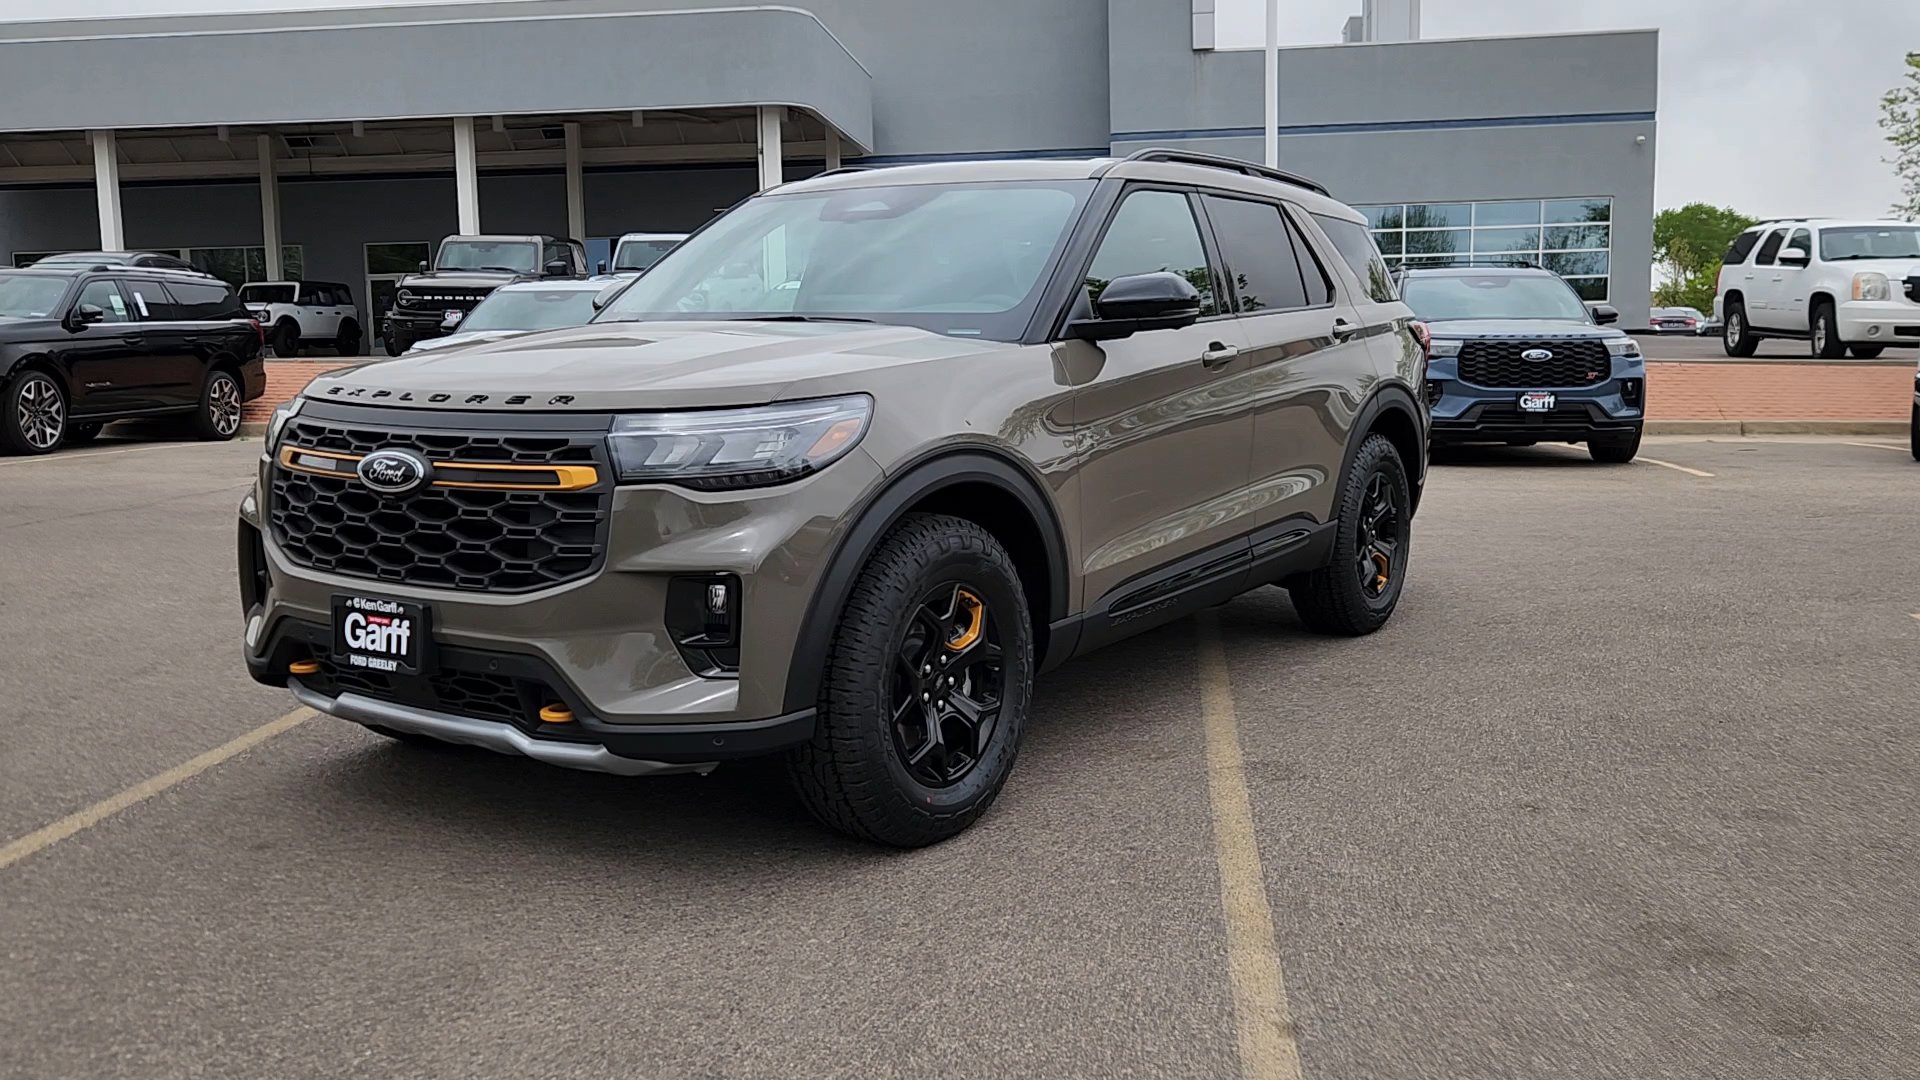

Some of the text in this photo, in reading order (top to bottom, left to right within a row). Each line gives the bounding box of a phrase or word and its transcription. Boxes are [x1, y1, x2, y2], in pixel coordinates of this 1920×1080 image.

[327, 386, 576, 405] EXPLORER
[1520, 395, 1555, 409] Garff
[368, 458, 406, 483] Ford
[344, 611, 411, 656] Garff
[349, 654, 368, 667] FORD
